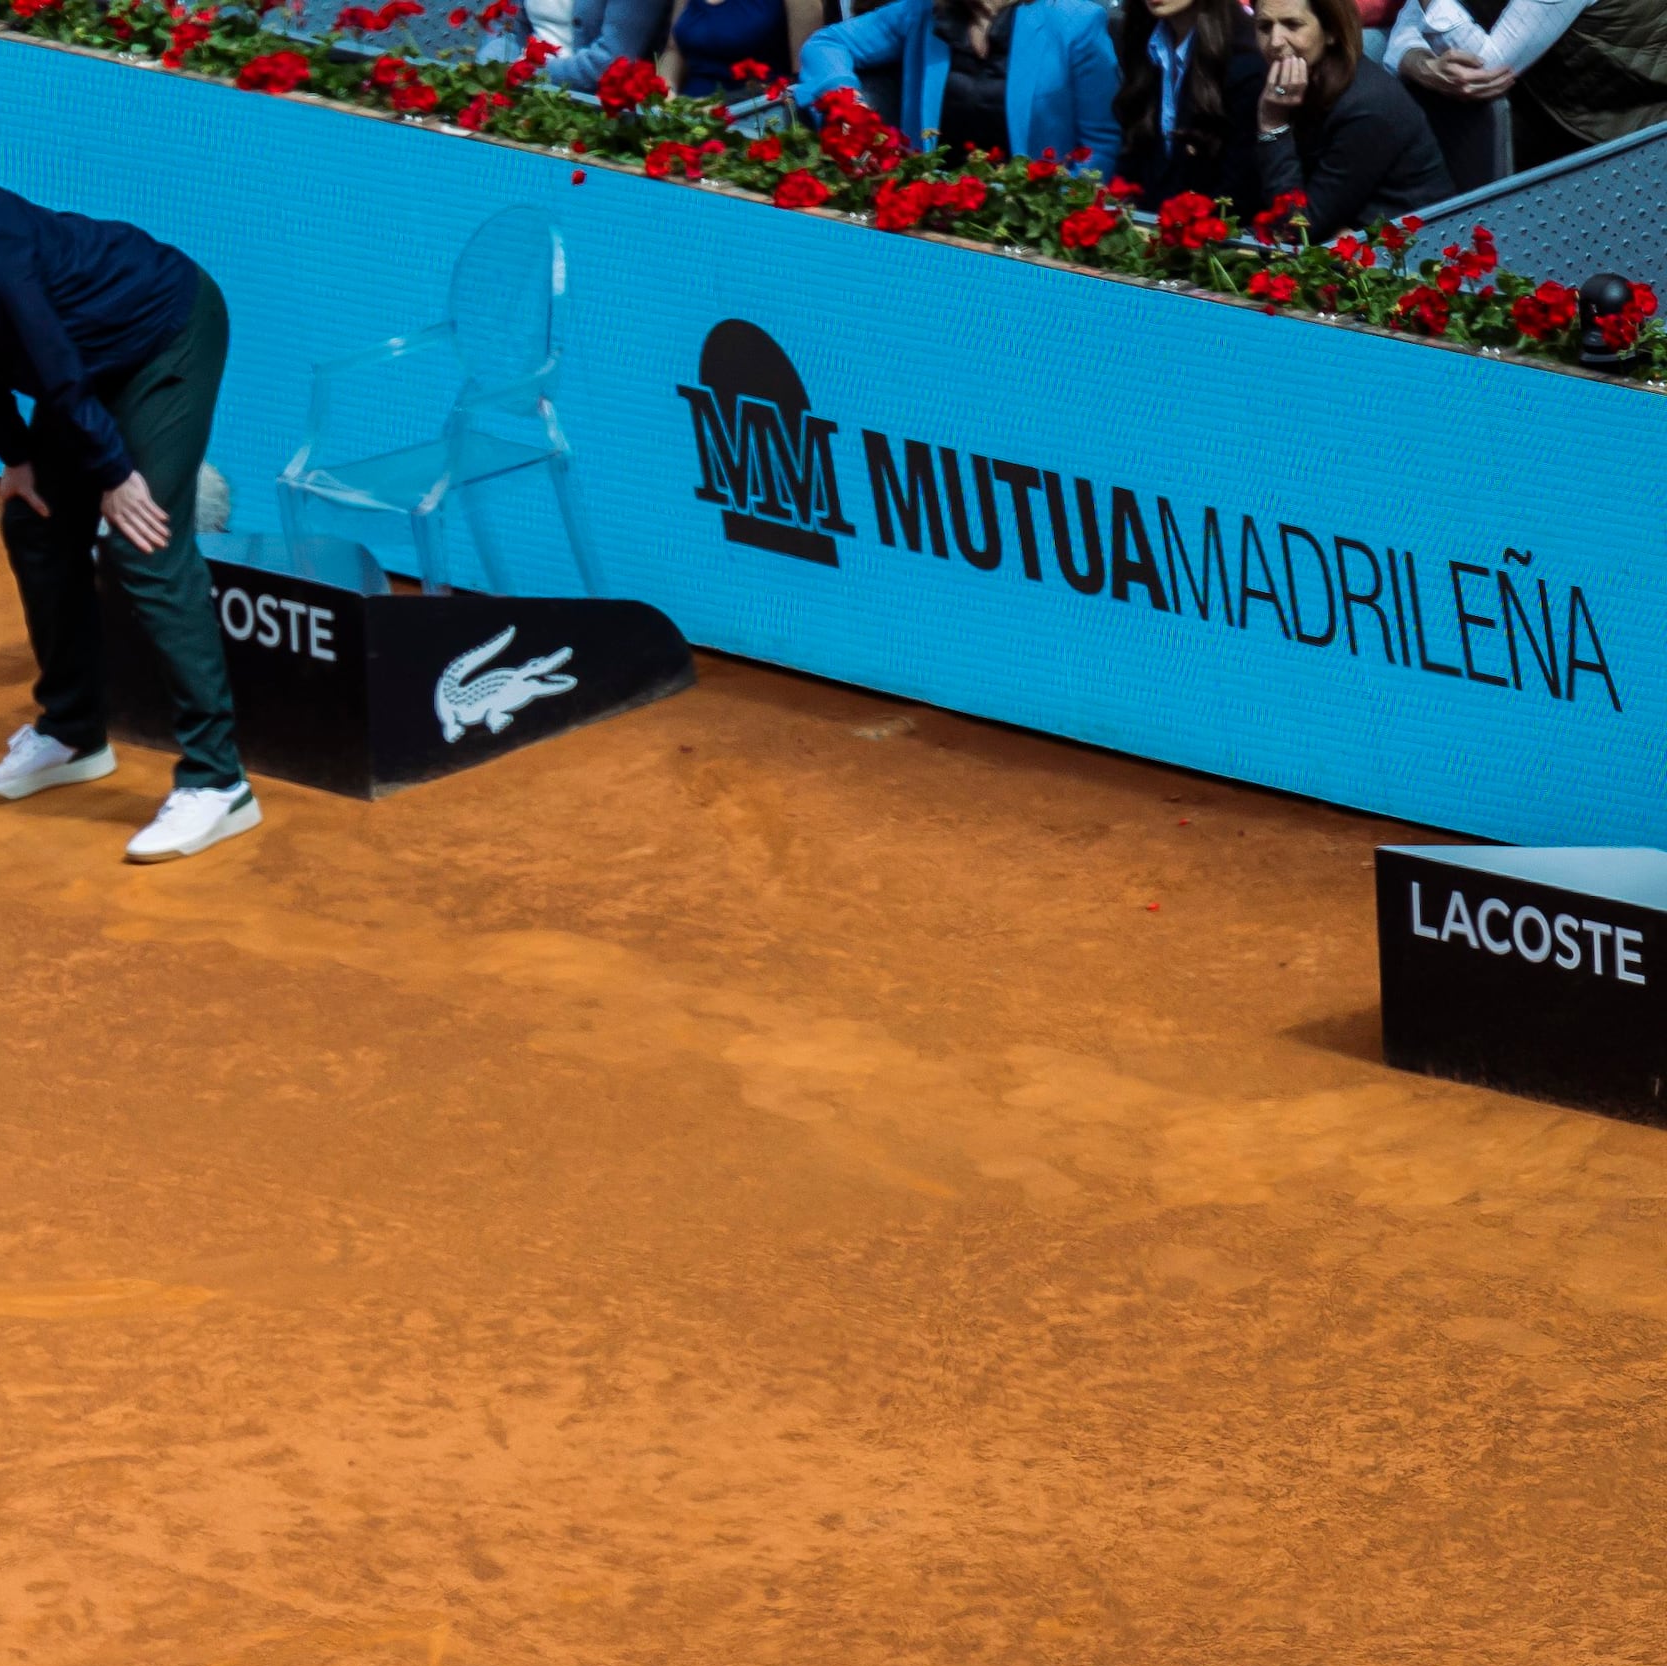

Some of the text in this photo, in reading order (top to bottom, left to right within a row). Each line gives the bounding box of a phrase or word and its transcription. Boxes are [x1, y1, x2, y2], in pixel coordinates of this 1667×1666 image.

[860, 427, 1624, 713] MUTUAMADRILEÑA
[210, 585, 336, 662] OSTE
[1411, 881, 1646, 985] LACOSTE
